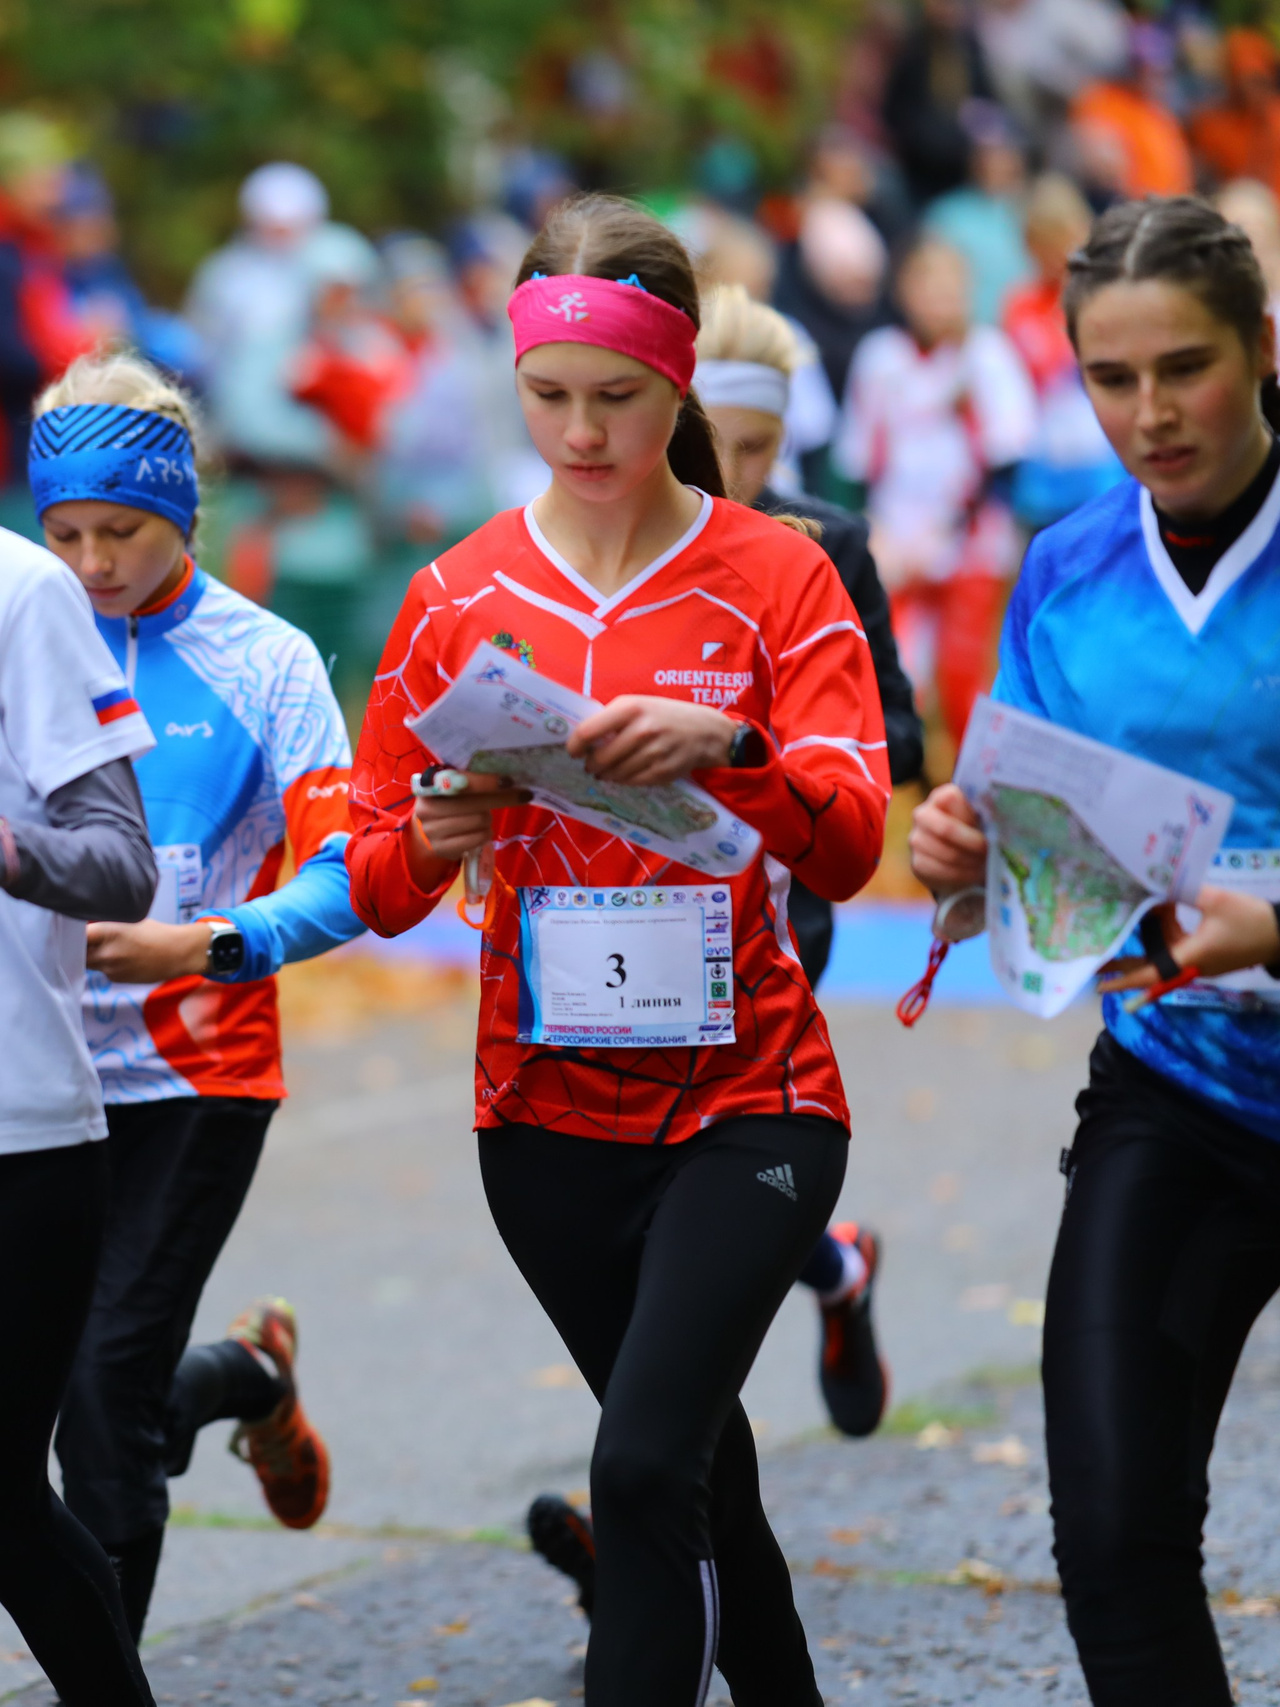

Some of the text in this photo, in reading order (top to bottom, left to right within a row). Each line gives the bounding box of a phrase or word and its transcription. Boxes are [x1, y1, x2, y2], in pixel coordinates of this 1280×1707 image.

[691, 687, 738, 705] TEAM
[606, 952, 627, 988] 3
[619, 995, 625, 1009] 1
[631, 997, 682, 1009] линия
[544, 1024, 632, 1035] ПЕРВЕНСТВО РОССИИ
[543, 1034, 688, 1046] СЕРОССИЙСКИЕ СОРЕВНОВАНИЯ
[756, 1171, 799, 1202] adidas
